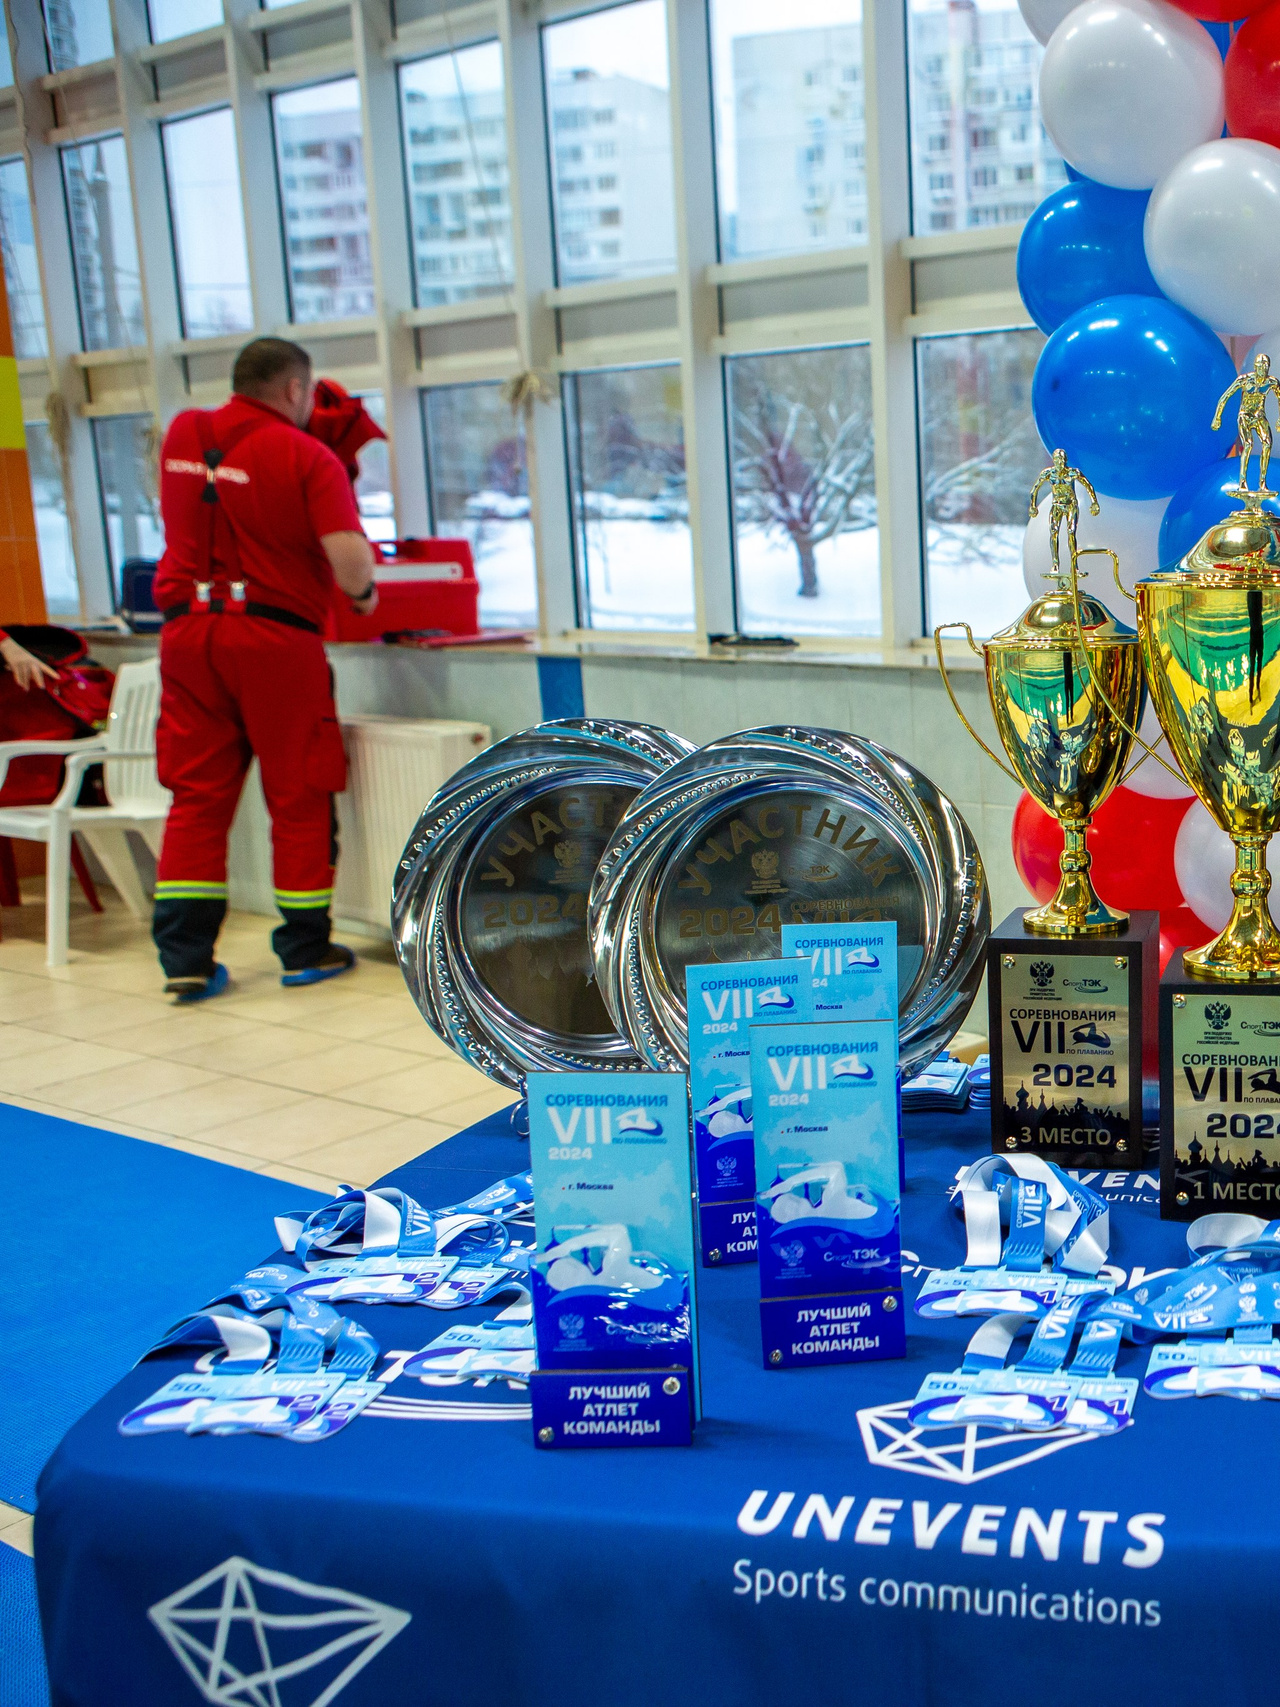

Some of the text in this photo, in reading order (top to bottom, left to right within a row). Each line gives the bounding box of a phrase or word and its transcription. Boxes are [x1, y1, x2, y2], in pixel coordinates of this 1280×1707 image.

[481, 797, 612, 887] УЧАСТ
[677, 804, 900, 896] УЧАСТНИК
[679, 904, 781, 938] 2024
[795, 937, 884, 949] СОРЕВНОВАНИЯ
[796, 948, 842, 976] VII
[701, 975, 798, 991] СОРЕВНОВАНИЯ
[702, 988, 753, 1021] VII
[816, 1003, 843, 1011] Москва
[1009, 1008, 1116, 1021] СОРЕВНОВАНИЯ
[703, 1022, 738, 1035] 2024
[1011, 1020, 1065, 1054] VII
[767, 1042, 879, 1057] СОРЕВНОВАНИЯ
[768, 1055, 827, 1091] VII
[1033, 1063, 1117, 1088] 2024
[1183, 1066, 1243, 1102] VII
[545, 1094, 668, 1107] СОРЕВНОВАНИЯ
[769, 1093, 809, 1106] 2024
[547, 1107, 612, 1145] VII
[1021, 1126, 1111, 1146] 3 МЕСТО
[548, 1147, 592, 1160] 2024
[1193, 1182, 1205, 1199] 1
[797, 1302, 871, 1323] ЛУЧШИЙ
[444, 1332, 474, 1342] 50
[809, 1321, 861, 1338] АТЛЕТ
[792, 1335, 880, 1355] КОМАНДЫ
[568, 1381, 650, 1400] ЛУЧШИЙ
[582, 1402, 639, 1417] АТЛЕТ
[563, 1420, 660, 1436] КОМАНДЫ
[736, 1489, 1167, 1569] UNEVENTS
[733, 1558, 1162, 1627] Sports communications
